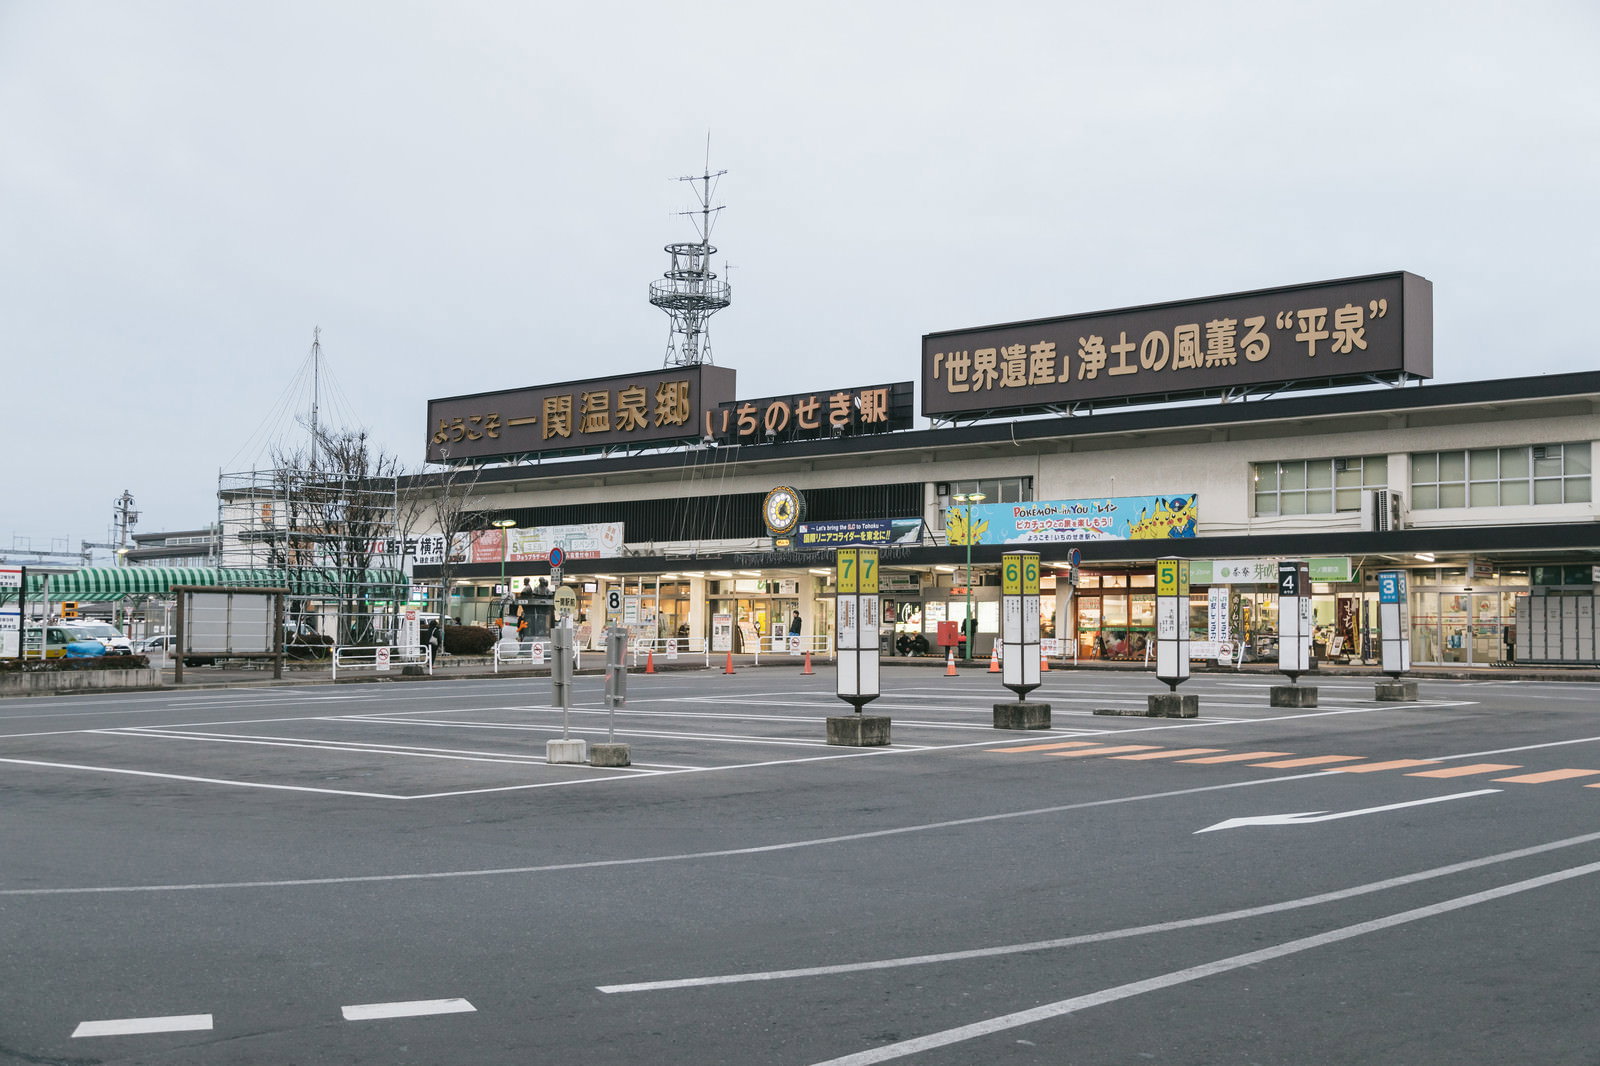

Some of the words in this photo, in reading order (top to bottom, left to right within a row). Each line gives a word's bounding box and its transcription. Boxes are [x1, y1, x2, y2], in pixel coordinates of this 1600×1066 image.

[705, 388, 889, 436] いちのせき駅
[1071, 505, 1088, 515] YOU
[842, 559, 853, 579] 7
[863, 559, 874, 579] 7
[1006, 563, 1018, 582] 6
[1025, 563, 1036, 582] 6
[1161, 568, 1174, 584] 5
[1282, 575, 1294, 590] 4
[1383, 579, 1395, 594] 3
[609, 592, 620, 608] 8
